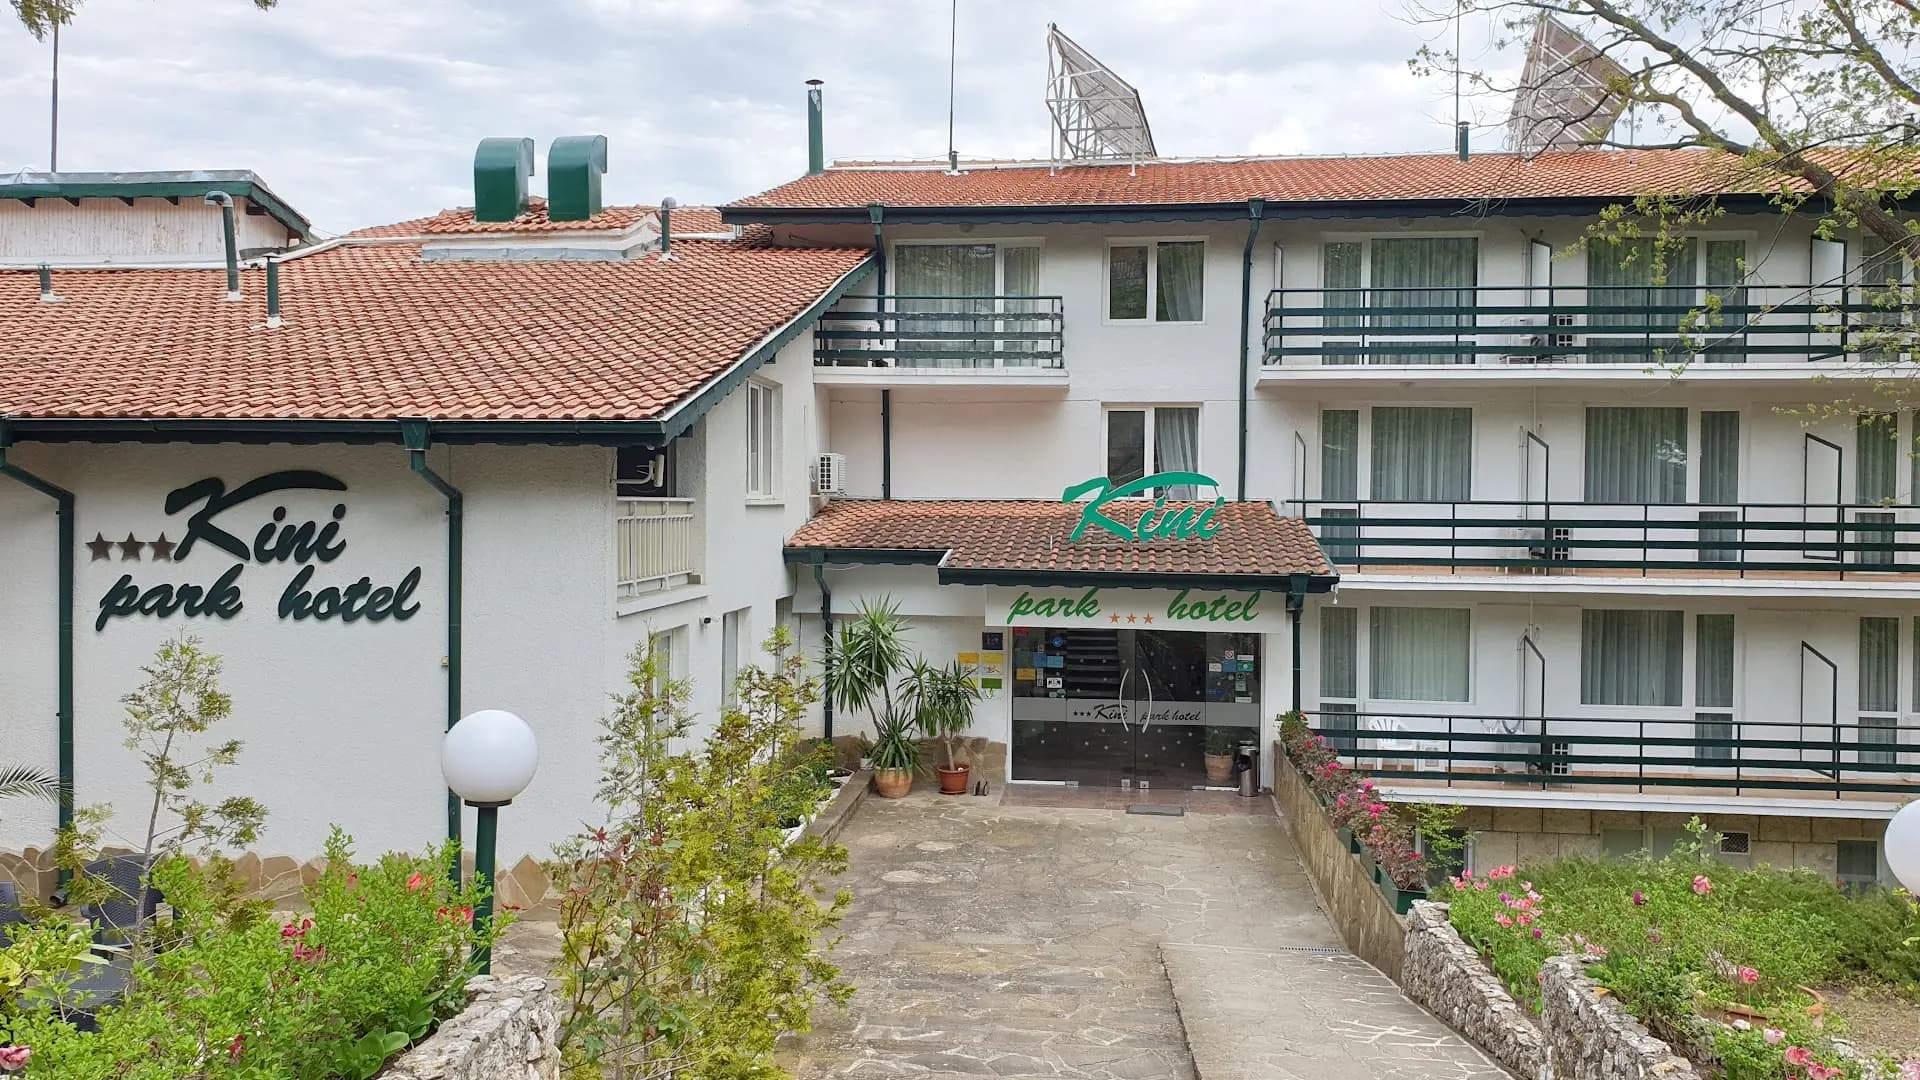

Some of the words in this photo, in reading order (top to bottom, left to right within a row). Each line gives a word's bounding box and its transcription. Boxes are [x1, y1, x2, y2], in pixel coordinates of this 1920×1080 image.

[165, 469, 348, 562] Kini
[1063, 471, 1225, 542] Kini
[95, 563, 244, 632] park
[277, 564, 422, 622] hotel
[1007, 586, 1101, 624] park
[1167, 588, 1260, 622] hotel
[1093, 704, 1128, 720] Kini
[1172, 709, 1201, 721] hotel
